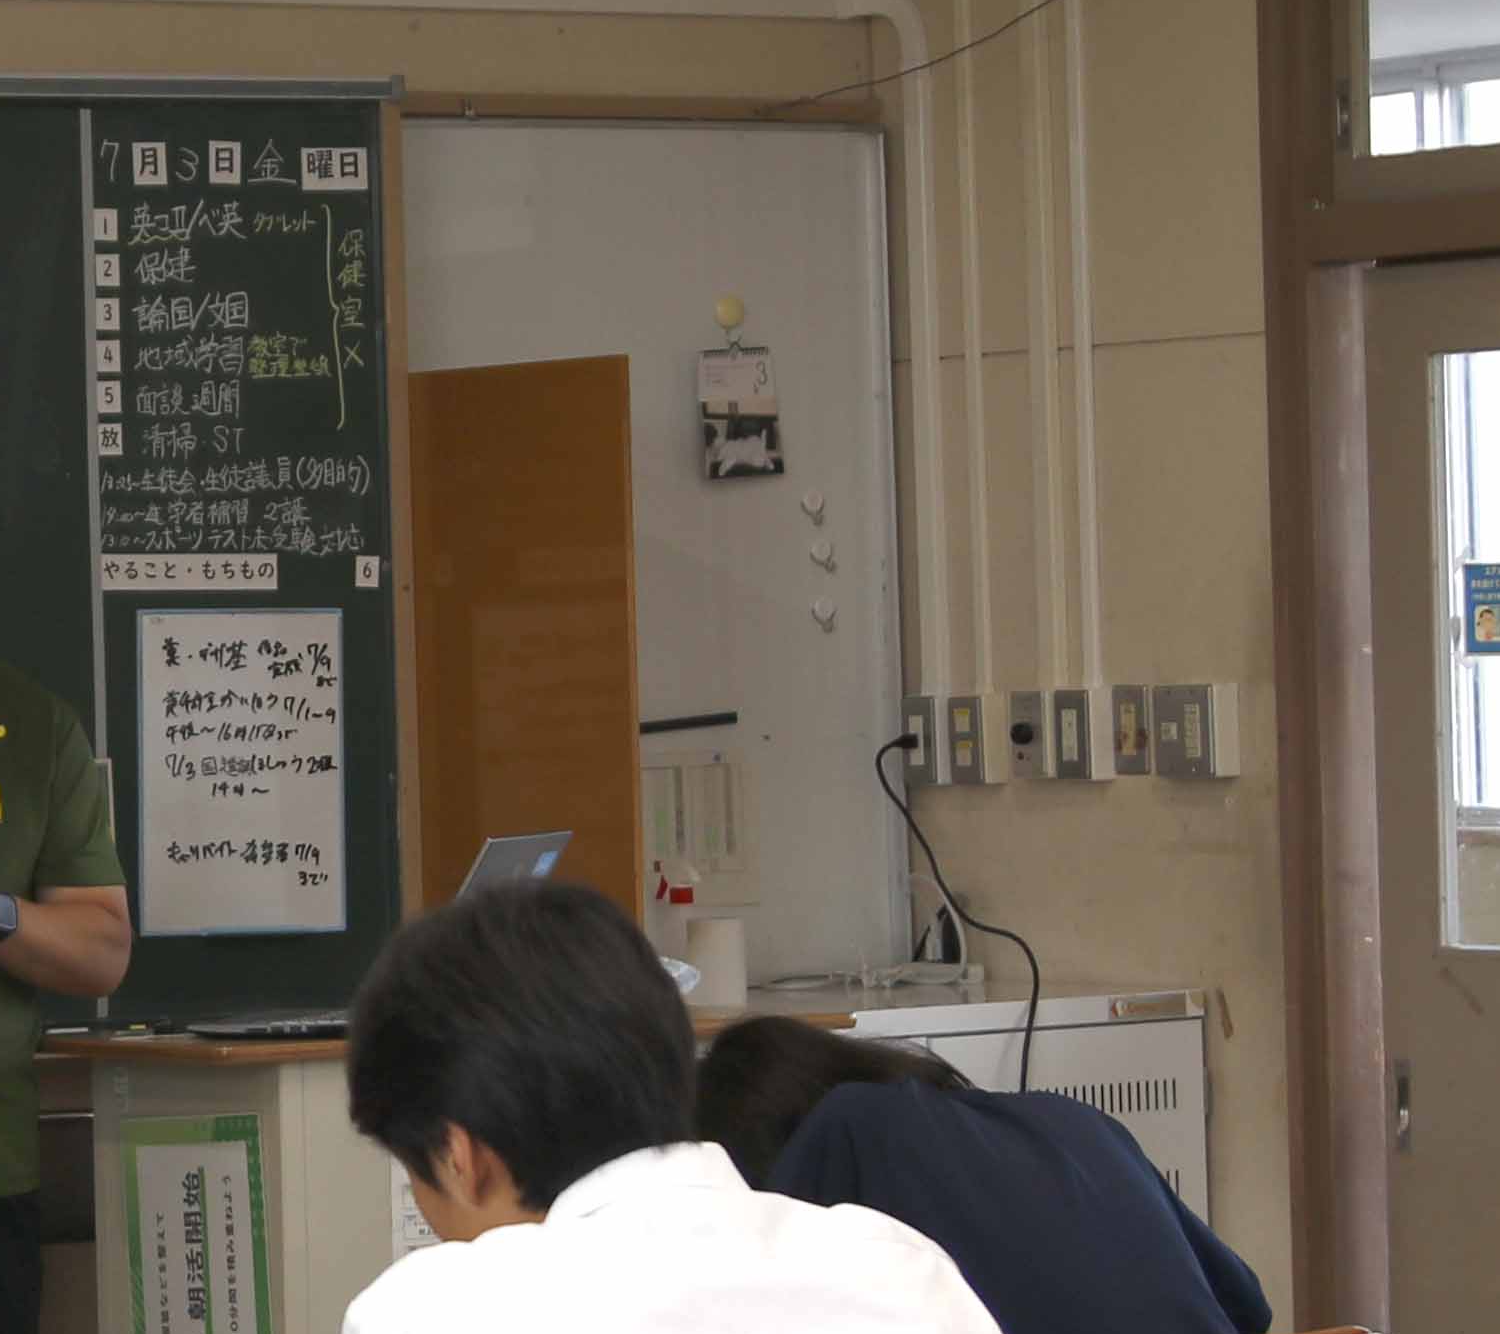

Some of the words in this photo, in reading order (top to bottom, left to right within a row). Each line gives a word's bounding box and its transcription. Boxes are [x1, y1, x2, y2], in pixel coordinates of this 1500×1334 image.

[103, 258, 113, 277] 2
[103, 303, 113, 322] 3
[103, 346, 114, 364] 4
[104, 386, 114, 404] 5
[103, 561, 275, 580] やること・もちもの
[362, 562, 372, 579] 6
[182, 1170, 204, 1321] 朝活開始
